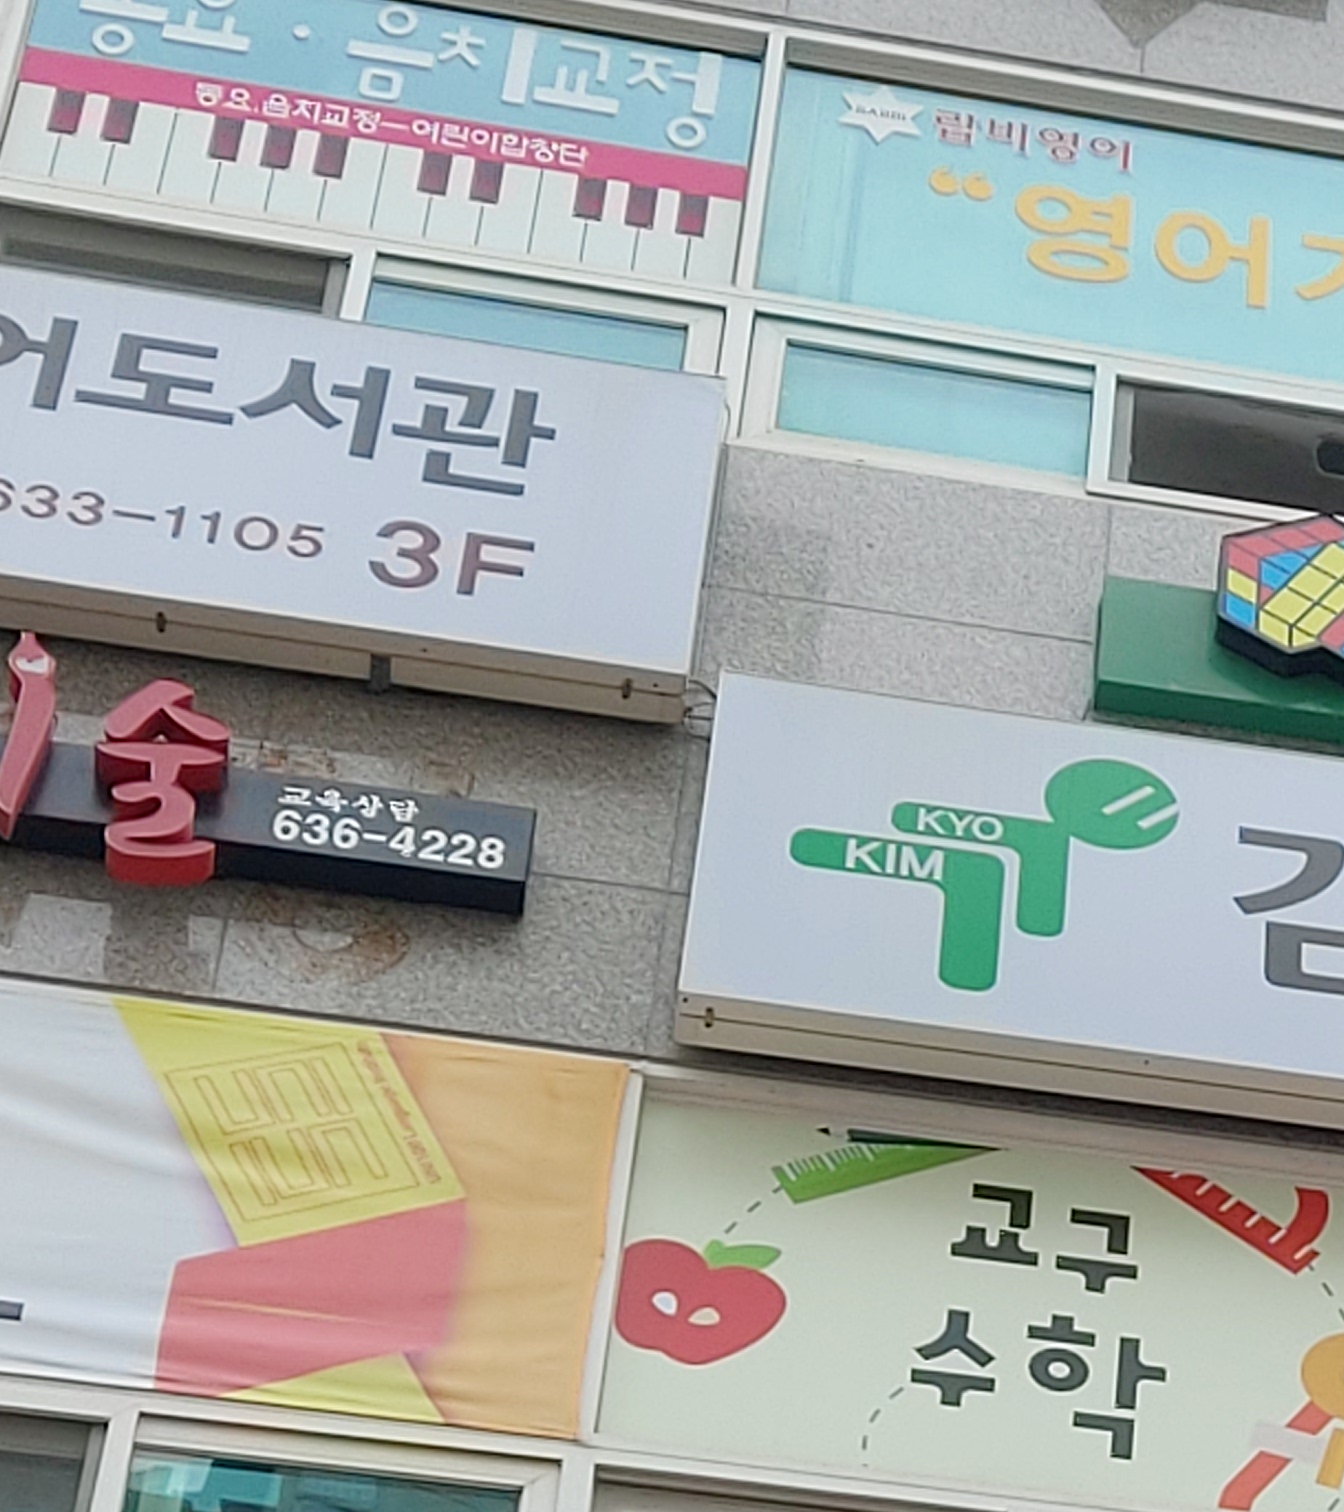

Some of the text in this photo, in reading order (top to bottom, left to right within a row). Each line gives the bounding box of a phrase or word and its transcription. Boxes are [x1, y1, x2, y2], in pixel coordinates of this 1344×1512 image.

[368, 520, 536, 597] 3F
[278, 785, 420, 823] 교육상담
[915, 806, 1004, 842] KYO
[273, 809, 506, 869] 636-4228
[844, 837, 946, 882] KIM
[950, 1182, 1138, 1294] 교구
[910, 1308, 1168, 1461] 수학
